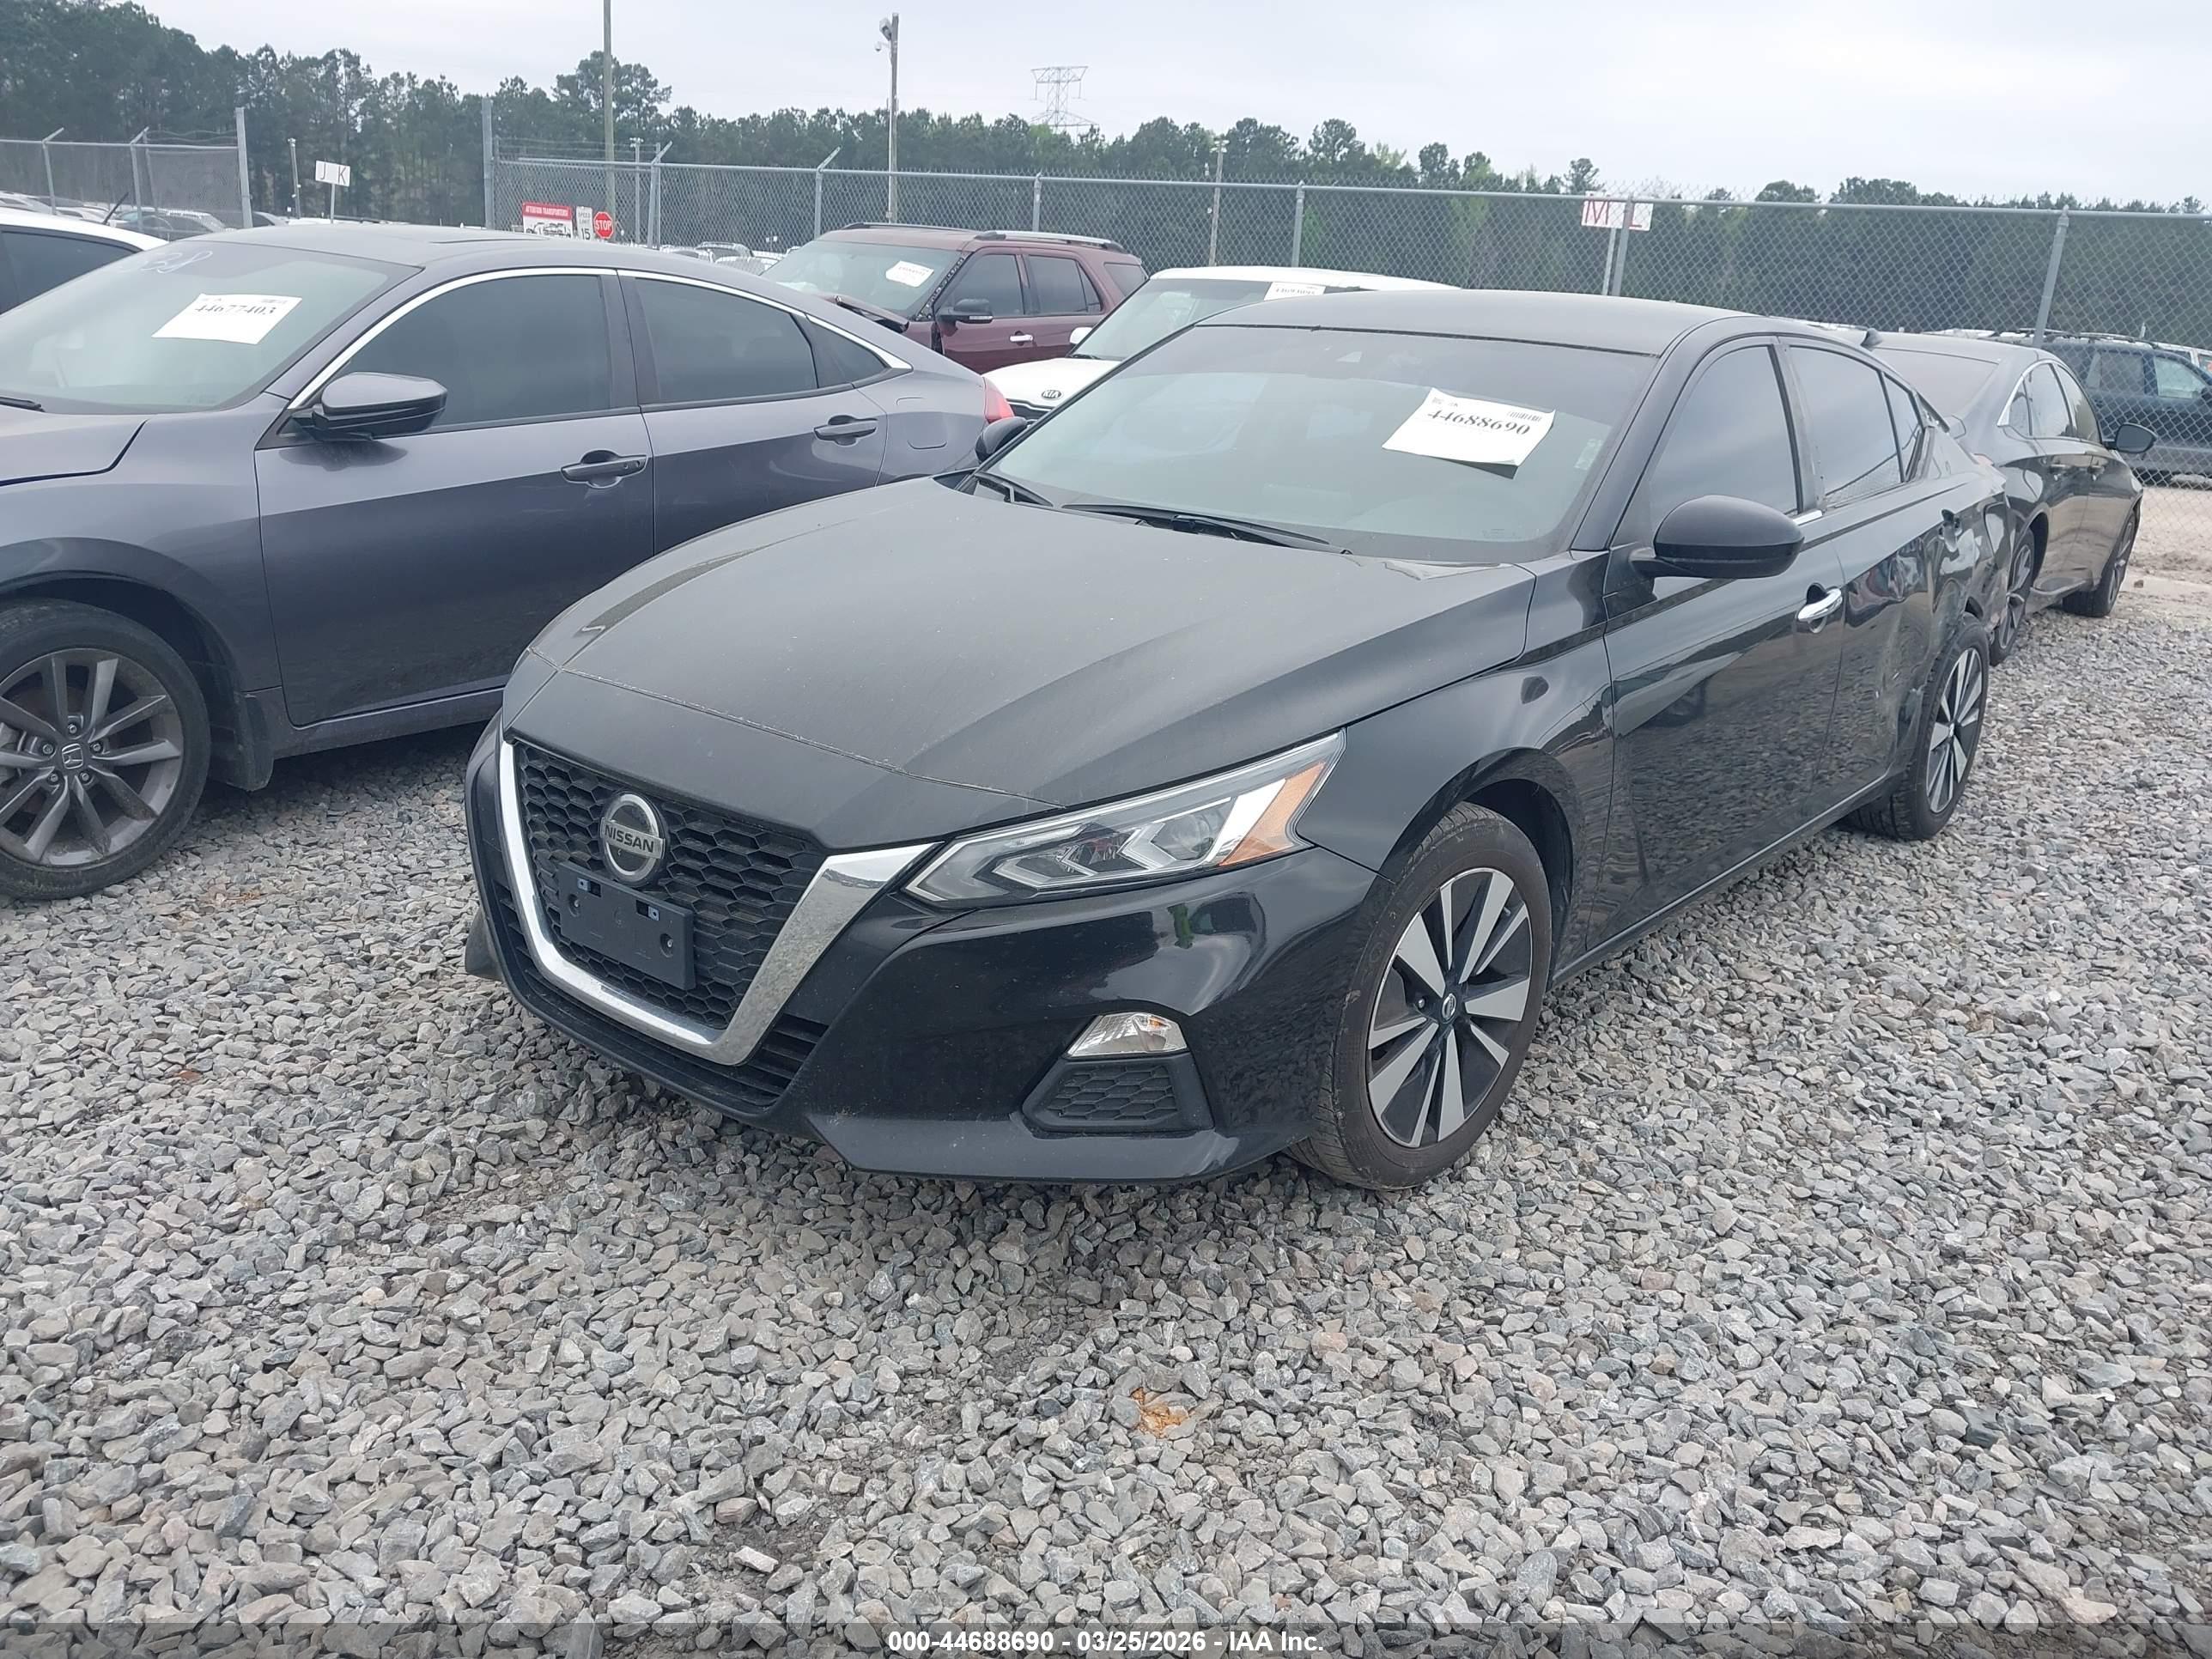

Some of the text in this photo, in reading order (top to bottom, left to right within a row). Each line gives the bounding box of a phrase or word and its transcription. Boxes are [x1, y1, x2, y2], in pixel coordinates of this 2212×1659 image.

[320, 163, 347, 185] J K
[1585, 194, 1610, 225] M
[581, 228, 591, 240] 15
[595, 220, 612, 231] STOP
[194, 304, 277, 315] 44677403
[1042, 390, 1060, 398] KIA
[1426, 409, 1531, 435] 44688690
[604, 824, 654, 853] NISSAN
